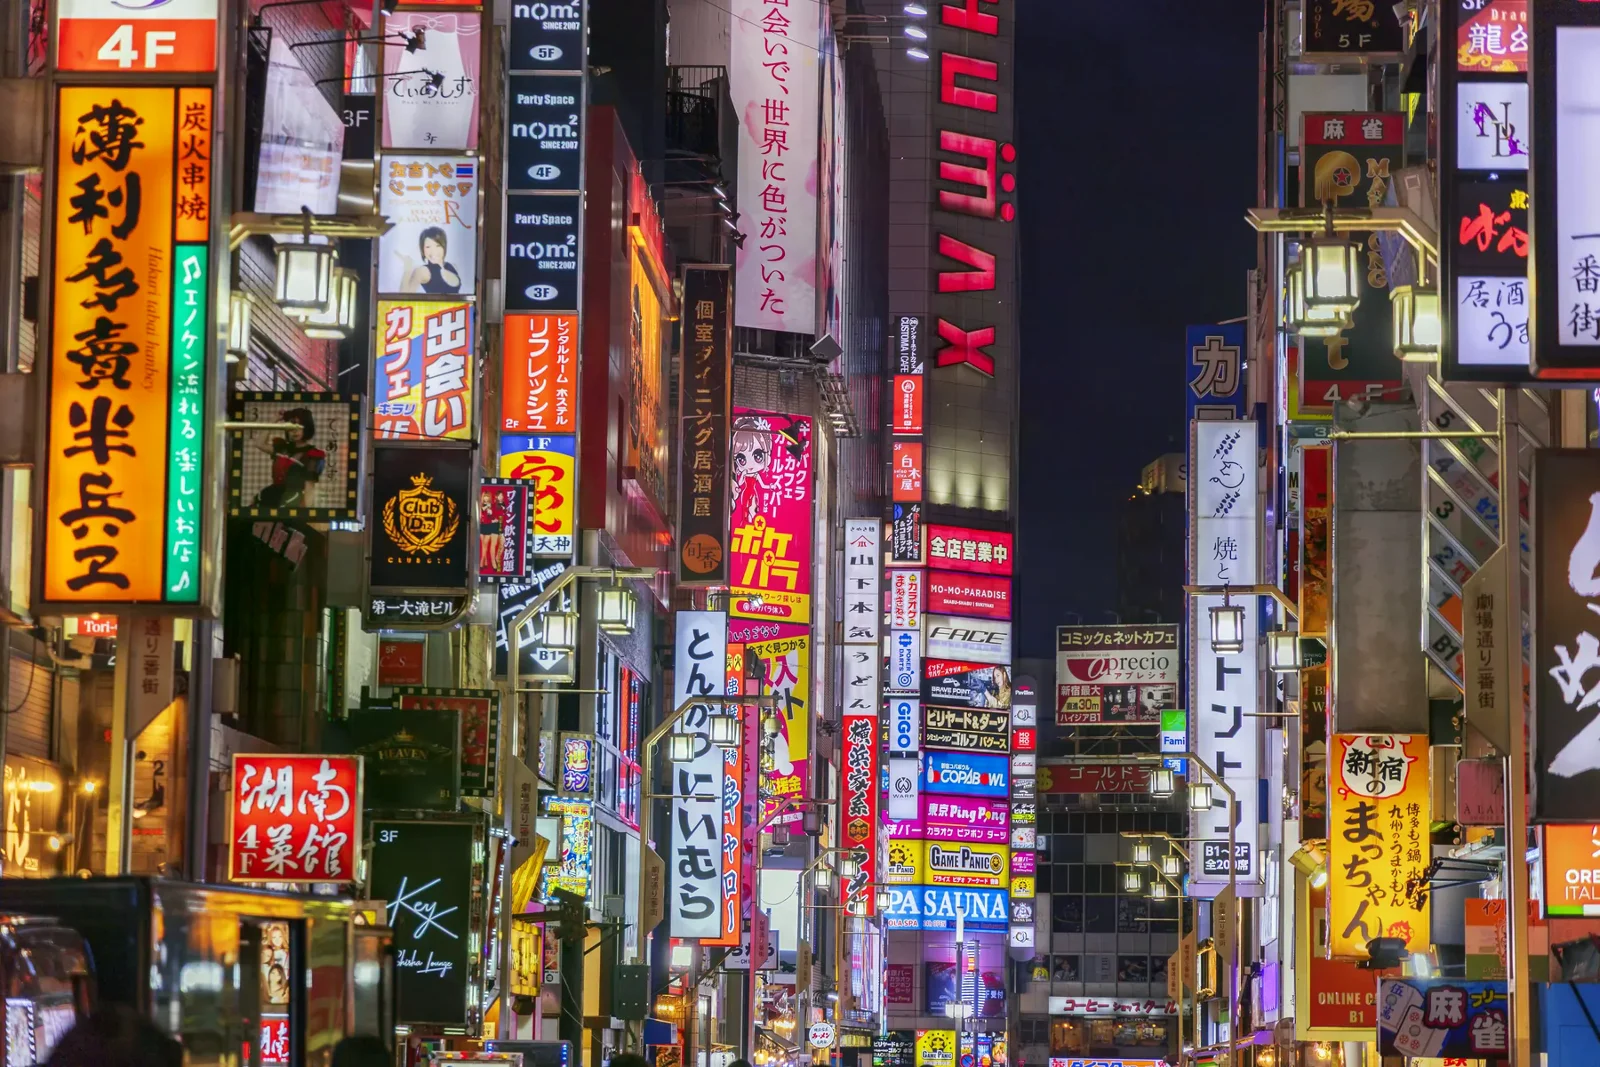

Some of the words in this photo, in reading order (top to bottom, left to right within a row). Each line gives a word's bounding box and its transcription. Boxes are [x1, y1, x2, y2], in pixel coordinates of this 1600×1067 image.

[542, 21, 562, 30] SINCE
[562, 21, 580, 30] 2007
[98, 25, 176, 68] 4F
[538, 48, 555, 59] 5F
[517, 94, 543, 106] Party
[544, 94, 575, 105] Space
[424, 132, 437, 145] 3F
[1323, 119, 1384, 140] 麻雀
[540, 140, 560, 150] SINCE
[560, 140, 578, 150] 2007
[176, 102, 208, 222] 炭火串焼
[536, 167, 552, 178] 4F
[515, 214, 541, 226] Party
[541, 214, 573, 225] Space
[538, 260, 557, 270] SINCE
[557, 260, 576, 270] 2007
[533, 287, 550, 299] 3F
[385, 307, 412, 400] カフェ
[557, 318, 569, 384] レンタルルーム
[424, 309, 467, 438] 出会い
[526, 318, 549, 430] リフレッシュ
[378, 403, 416, 416] キラリ
[555, 388, 569, 425] ホステル
[692, 299, 715, 516] 個室ダイニング居酒屋
[505, 418, 519, 429] 2F
[1436, 410, 1456, 428] 5
[380, 421, 410, 440] 1F
[526, 437, 551, 450] 1F
[900, 455, 922, 490] 白木屋
[404, 500, 440, 514] Club
[1436, 501, 1455, 519] 3
[503, 490, 517, 572] ワイン飲み放題
[536, 537, 571, 552] 天神
[685, 540, 721, 569] 旬香
[930, 537, 1008, 564] 全店営業中
[895, 575, 905, 627] まねきねこ
[907, 582, 918, 619] カラオケ
[930, 585, 1007, 600] MO-MO-PARADISE
[372, 600, 459, 617] 第一大滝ビル
[929, 627, 1008, 645] FACE
[1061, 631, 1175, 646] コミック&ネットカフェ
[539, 650, 557, 661] B1
[1432, 635, 1460, 661] B1
[1476, 593, 1495, 708] 劇場通り一番街
[1087, 652, 1169, 679] aprecio
[1060, 686, 1101, 696] 新宿最大
[898, 702, 911, 748] GiGO
[927, 709, 1008, 733] ビリヤード&ダーツ
[1060, 713, 1101, 722] ハイジアB1
[979, 736, 1007, 749] バグース
[1164, 736, 1186, 745] Fami
[378, 748, 428, 760] HEAVEN
[847, 719, 872, 817] 横浜家系
[240, 759, 350, 822] 湖南
[928, 803, 949, 817] 東京
[950, 805, 976, 823] Ping
[978, 806, 1006, 825] Pong
[380, 830, 398, 843] 3F
[927, 827, 953, 837] カラオケ
[987, 830, 1007, 840] ダーツ
[1406, 803, 1421, 863] 博多もつ鍋
[238, 825, 260, 875] 4F
[262, 823, 348, 877] 菜館
[931, 845, 959, 868] GAME
[961, 846, 990, 870] PANIC
[1388, 804, 1404, 907] 九州のうまかもん
[1342, 801, 1387, 941] まっちゃん
[386, 877, 459, 940] Key
[924, 890, 1007, 919] SAUNA
[418, 951, 453, 973] Lounge
[1064, 999, 1109, 1012] コーヒー
[1143, 1000, 1177, 1014] クール
[1318, 992, 1361, 1005] ONLINE
[1349, 1011, 1364, 1023] B1
[1428, 989, 1506, 1050] 麻雀
